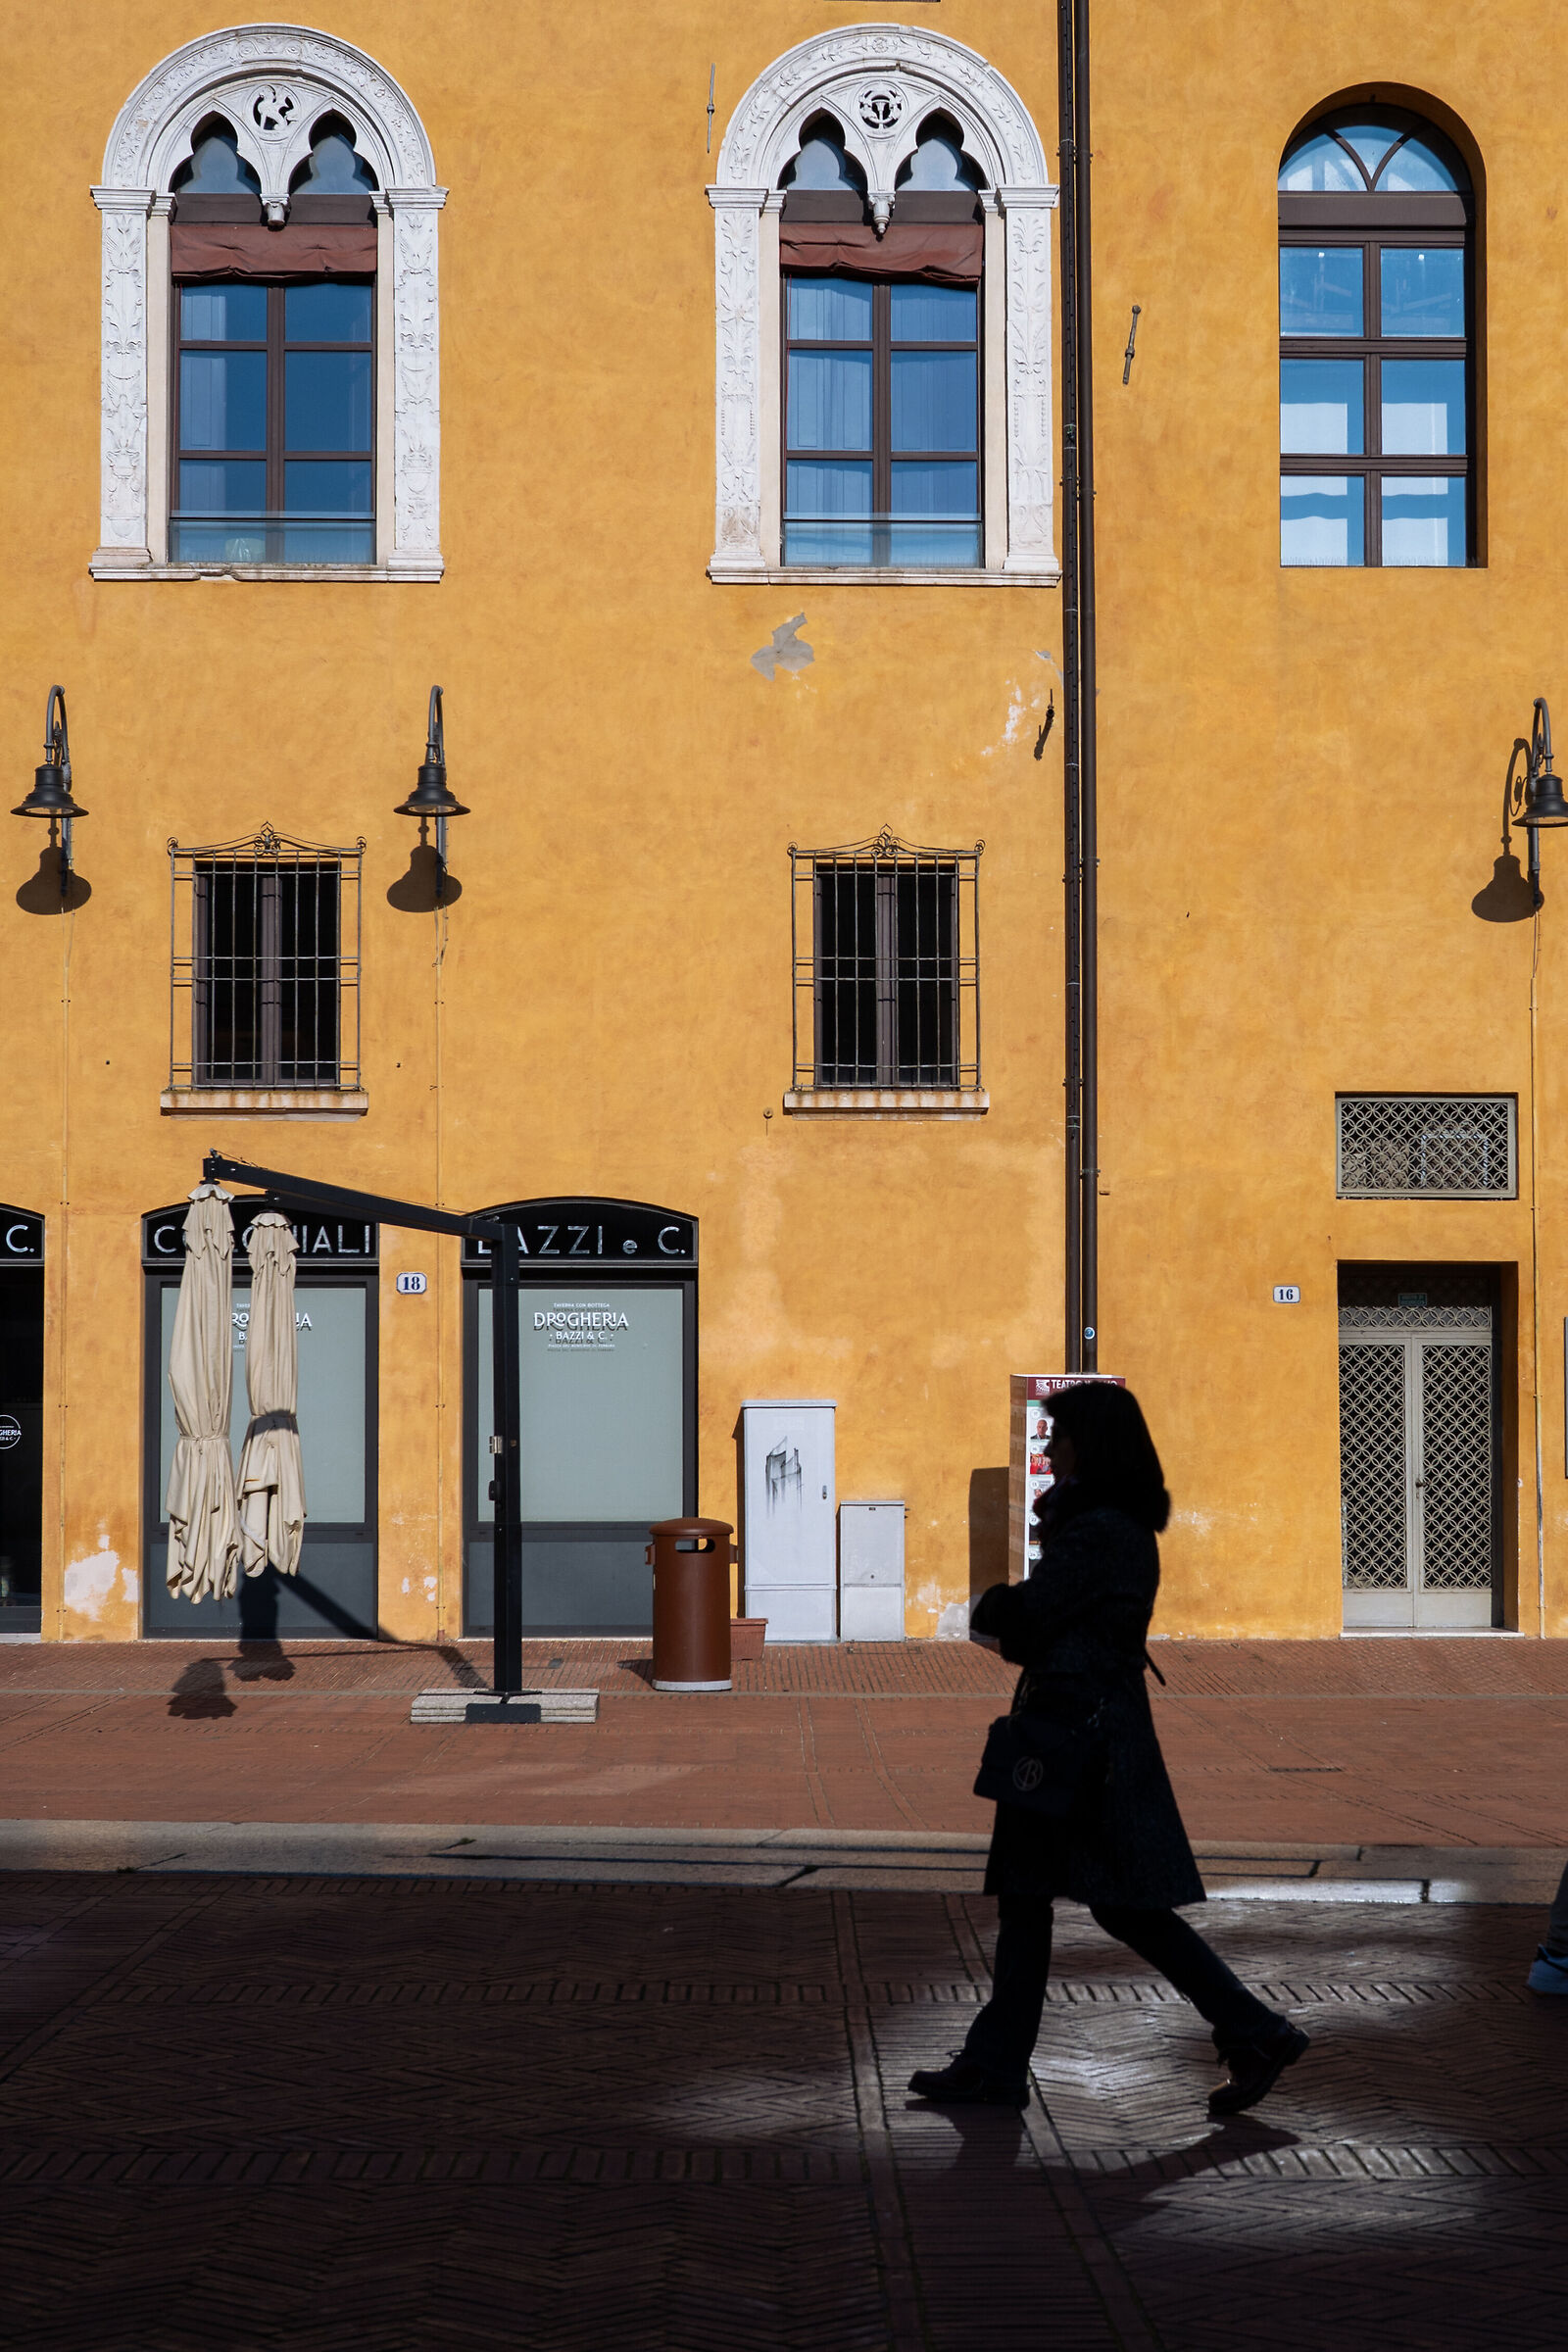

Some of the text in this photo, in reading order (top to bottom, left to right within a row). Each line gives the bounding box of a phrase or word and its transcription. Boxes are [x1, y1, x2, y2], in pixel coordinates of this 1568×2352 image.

[5, 1224, 35, 1253] C.
[154, 1225, 370, 1253] CIALI
[622, 1239, 638, 1254] e
[657, 1226, 686, 1254] C.
[403, 1276, 420, 1291] 18
[1278, 1288, 1294, 1300] 16
[533, 1312, 629, 1327] DROGHERIA
[556, 1331, 584, 1340] BAZZI
[586, 1331, 595, 1340] &
